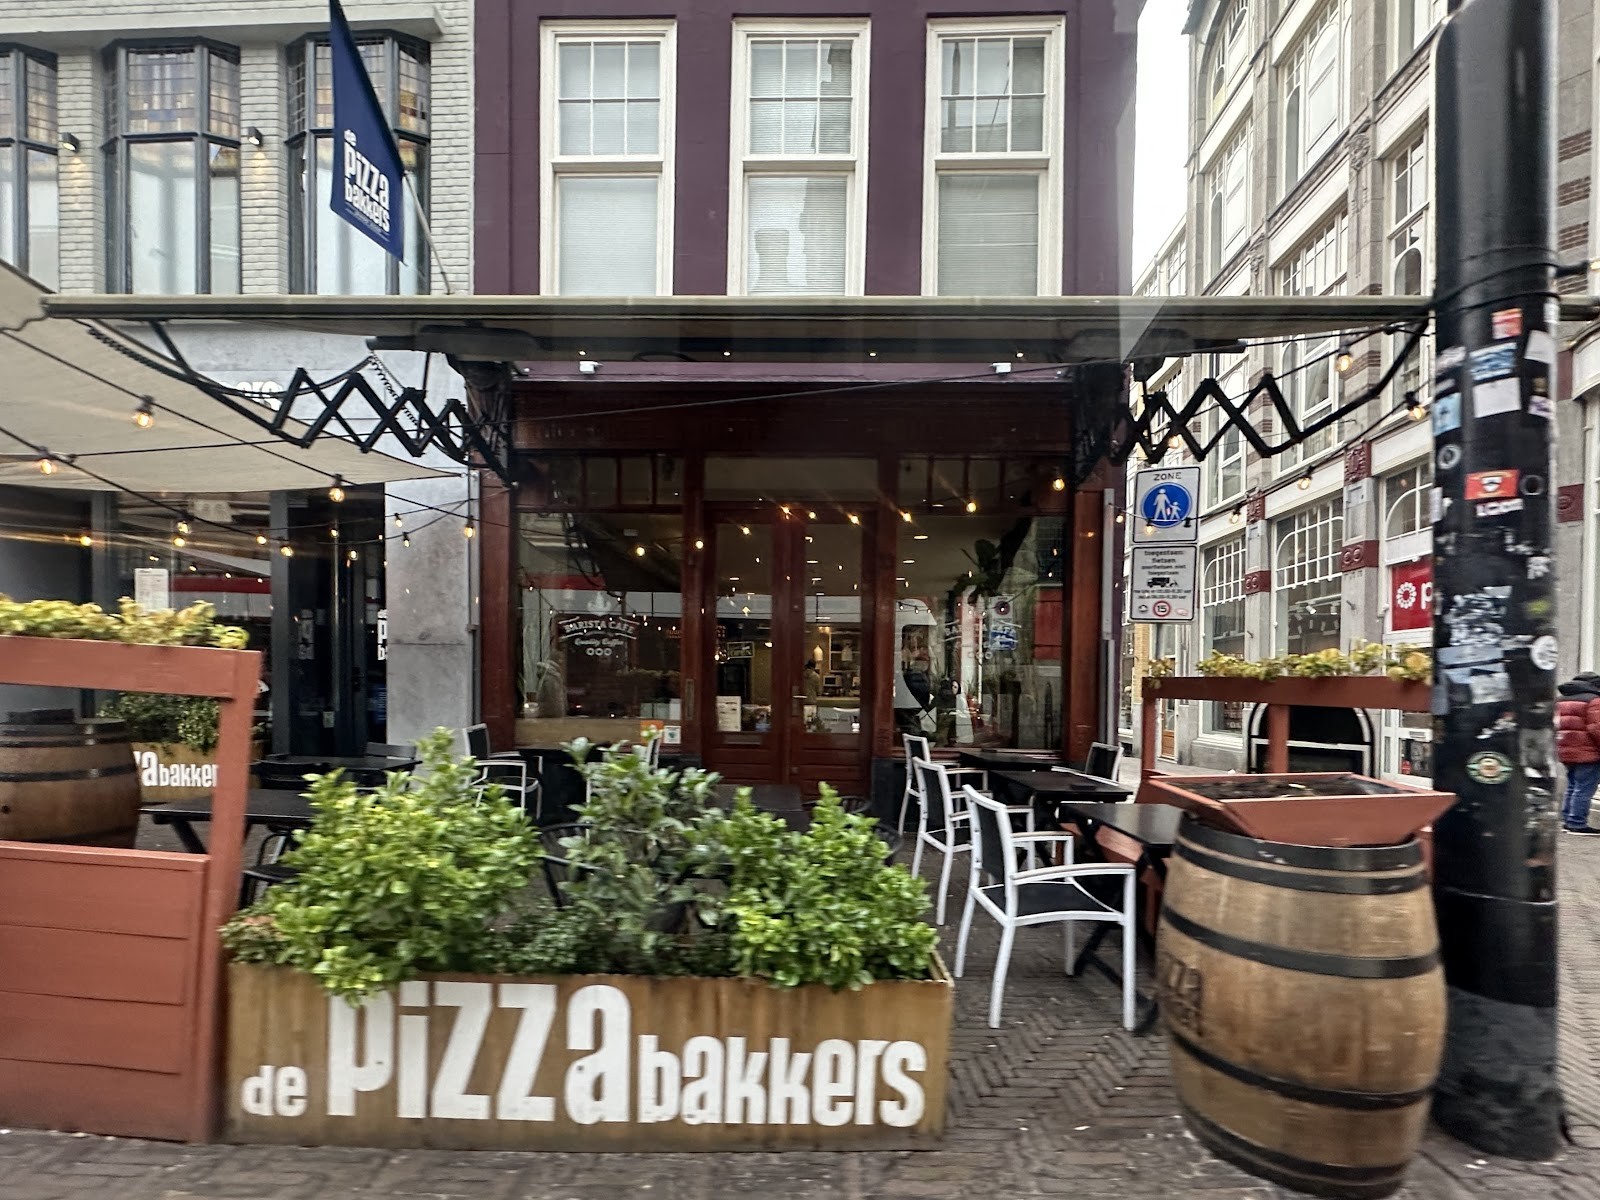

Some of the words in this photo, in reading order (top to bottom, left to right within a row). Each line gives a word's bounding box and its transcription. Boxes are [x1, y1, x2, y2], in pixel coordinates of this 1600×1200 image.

[344, 141, 390, 211] pizza
[344, 177, 390, 232] bakkers
[1153, 472, 1182, 481] ZONE
[1157, 605, 1167, 613] 15
[563, 621, 608, 634] BARISTA
[241, 1064, 308, 1117] de
[326, 980, 631, 1126] pizza
[636, 1033, 928, 1128] bakkers
